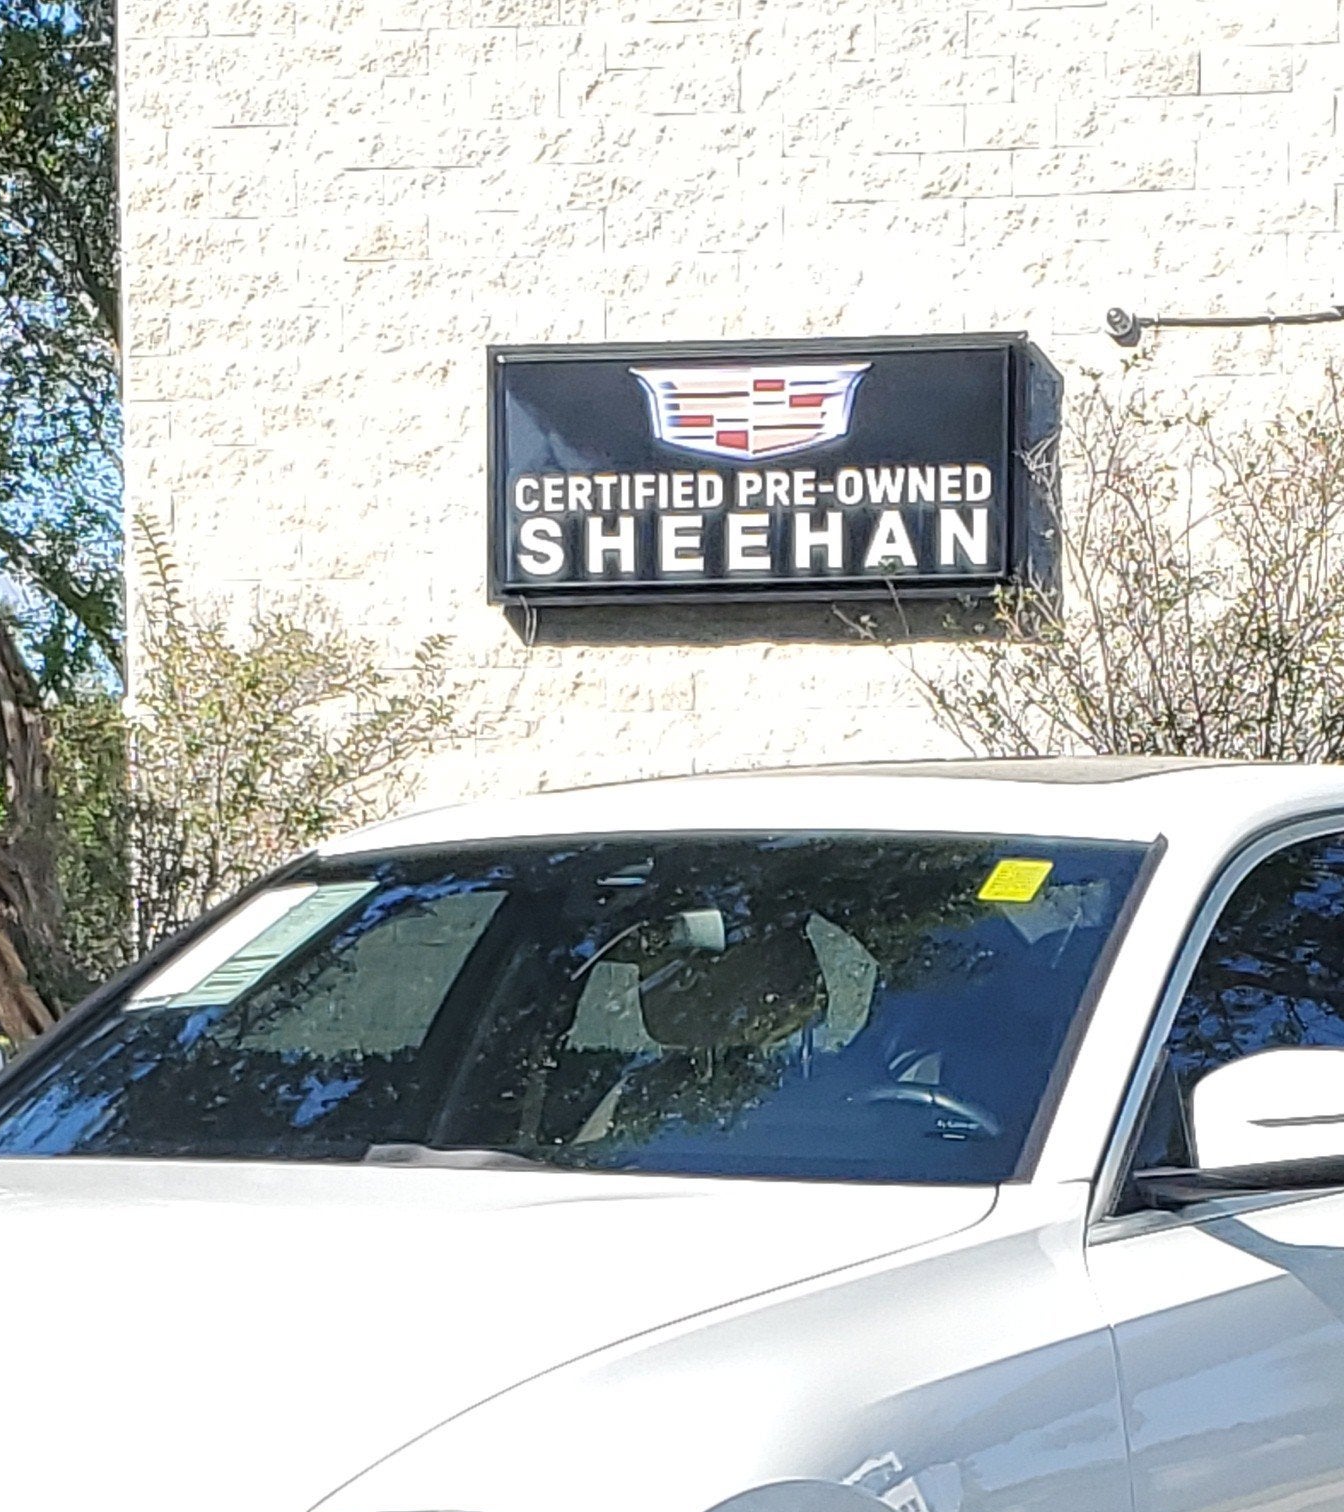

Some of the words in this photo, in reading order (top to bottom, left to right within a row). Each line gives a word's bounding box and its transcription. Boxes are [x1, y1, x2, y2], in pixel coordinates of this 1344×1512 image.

[515, 472, 723, 512] CERTIFIED
[737, 465, 992, 507] PRE-OWNED
[517, 508, 988, 576] SHEEHAN
